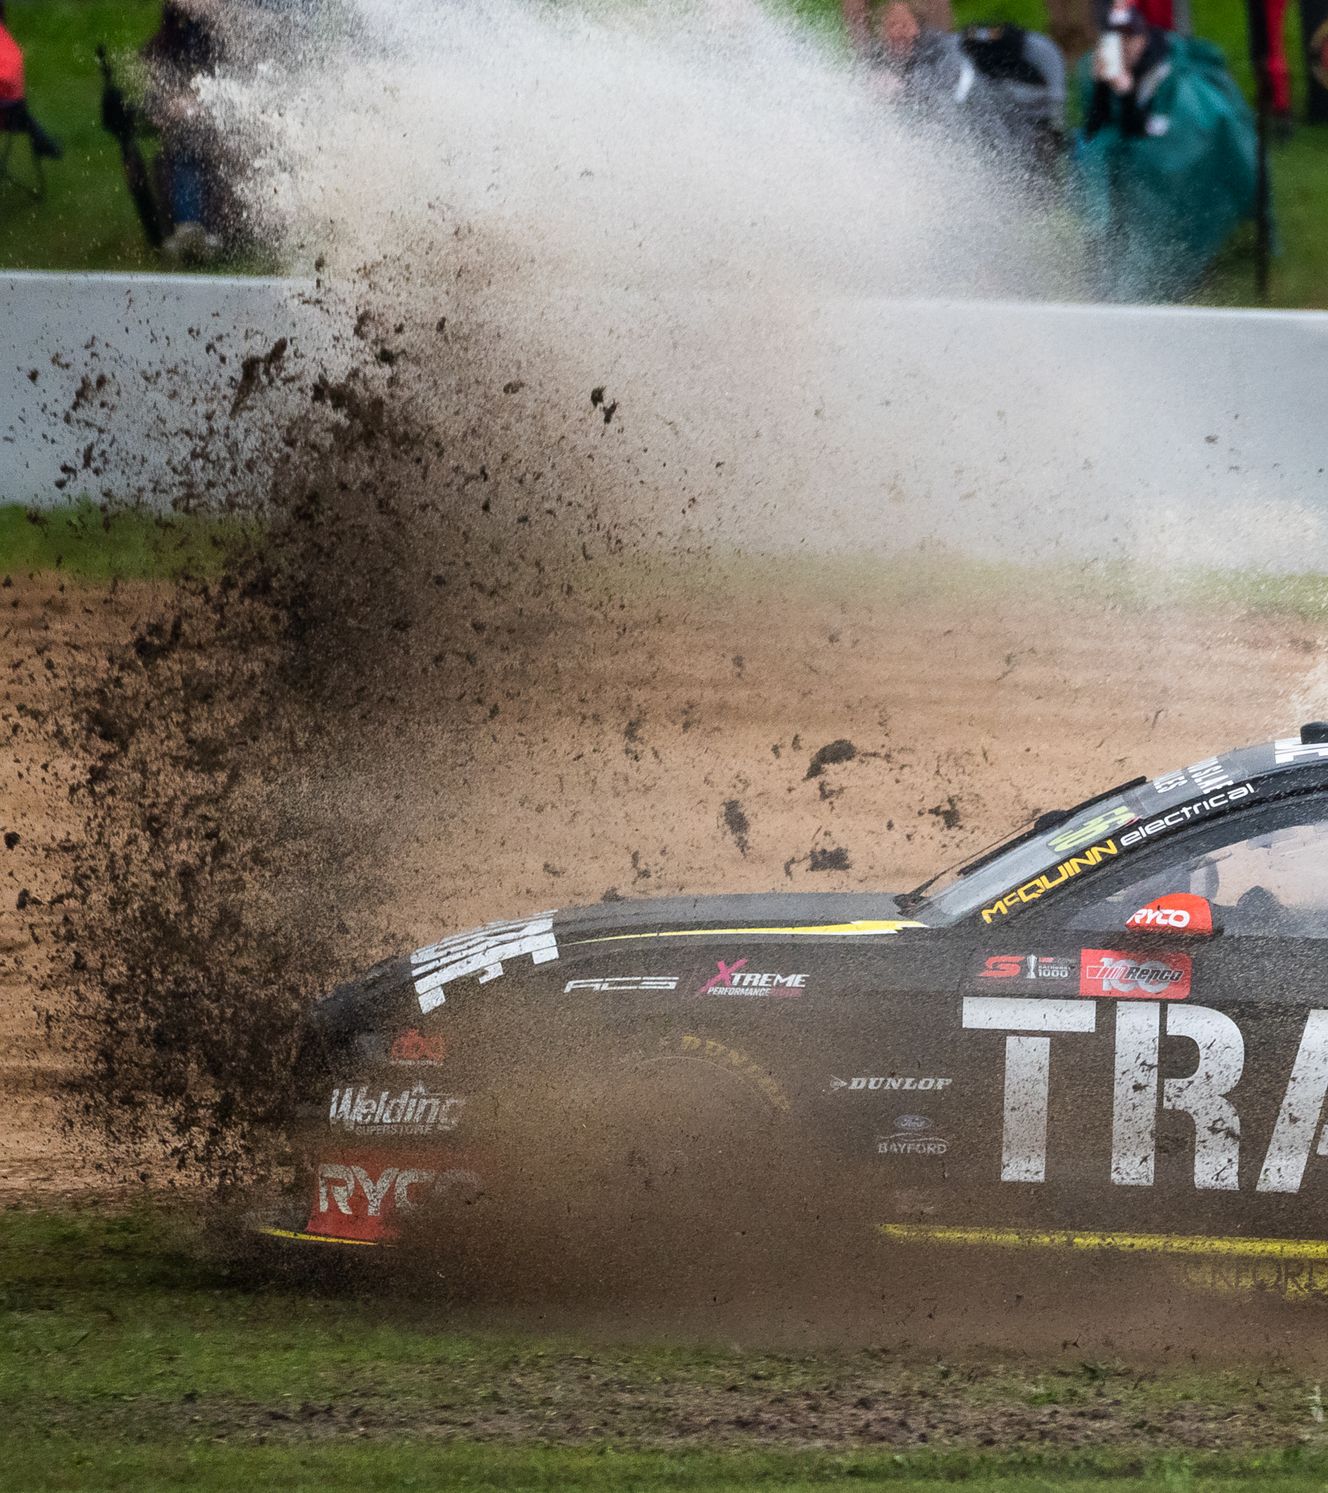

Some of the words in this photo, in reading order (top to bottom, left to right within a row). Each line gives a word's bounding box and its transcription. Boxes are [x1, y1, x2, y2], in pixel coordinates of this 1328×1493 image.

[1119, 782, 1256, 848] electrical
[1126, 908, 1191, 928] RYCO
[701, 957, 811, 993] XTREME
[1038, 968, 1069, 978] 1000
[1125, 965, 1184, 983] Repco
[707, 986, 771, 997] PERFORMANCE
[847, 1077, 953, 1091] DUNLOP
[878, 1142, 948, 1154] BAYFORD
